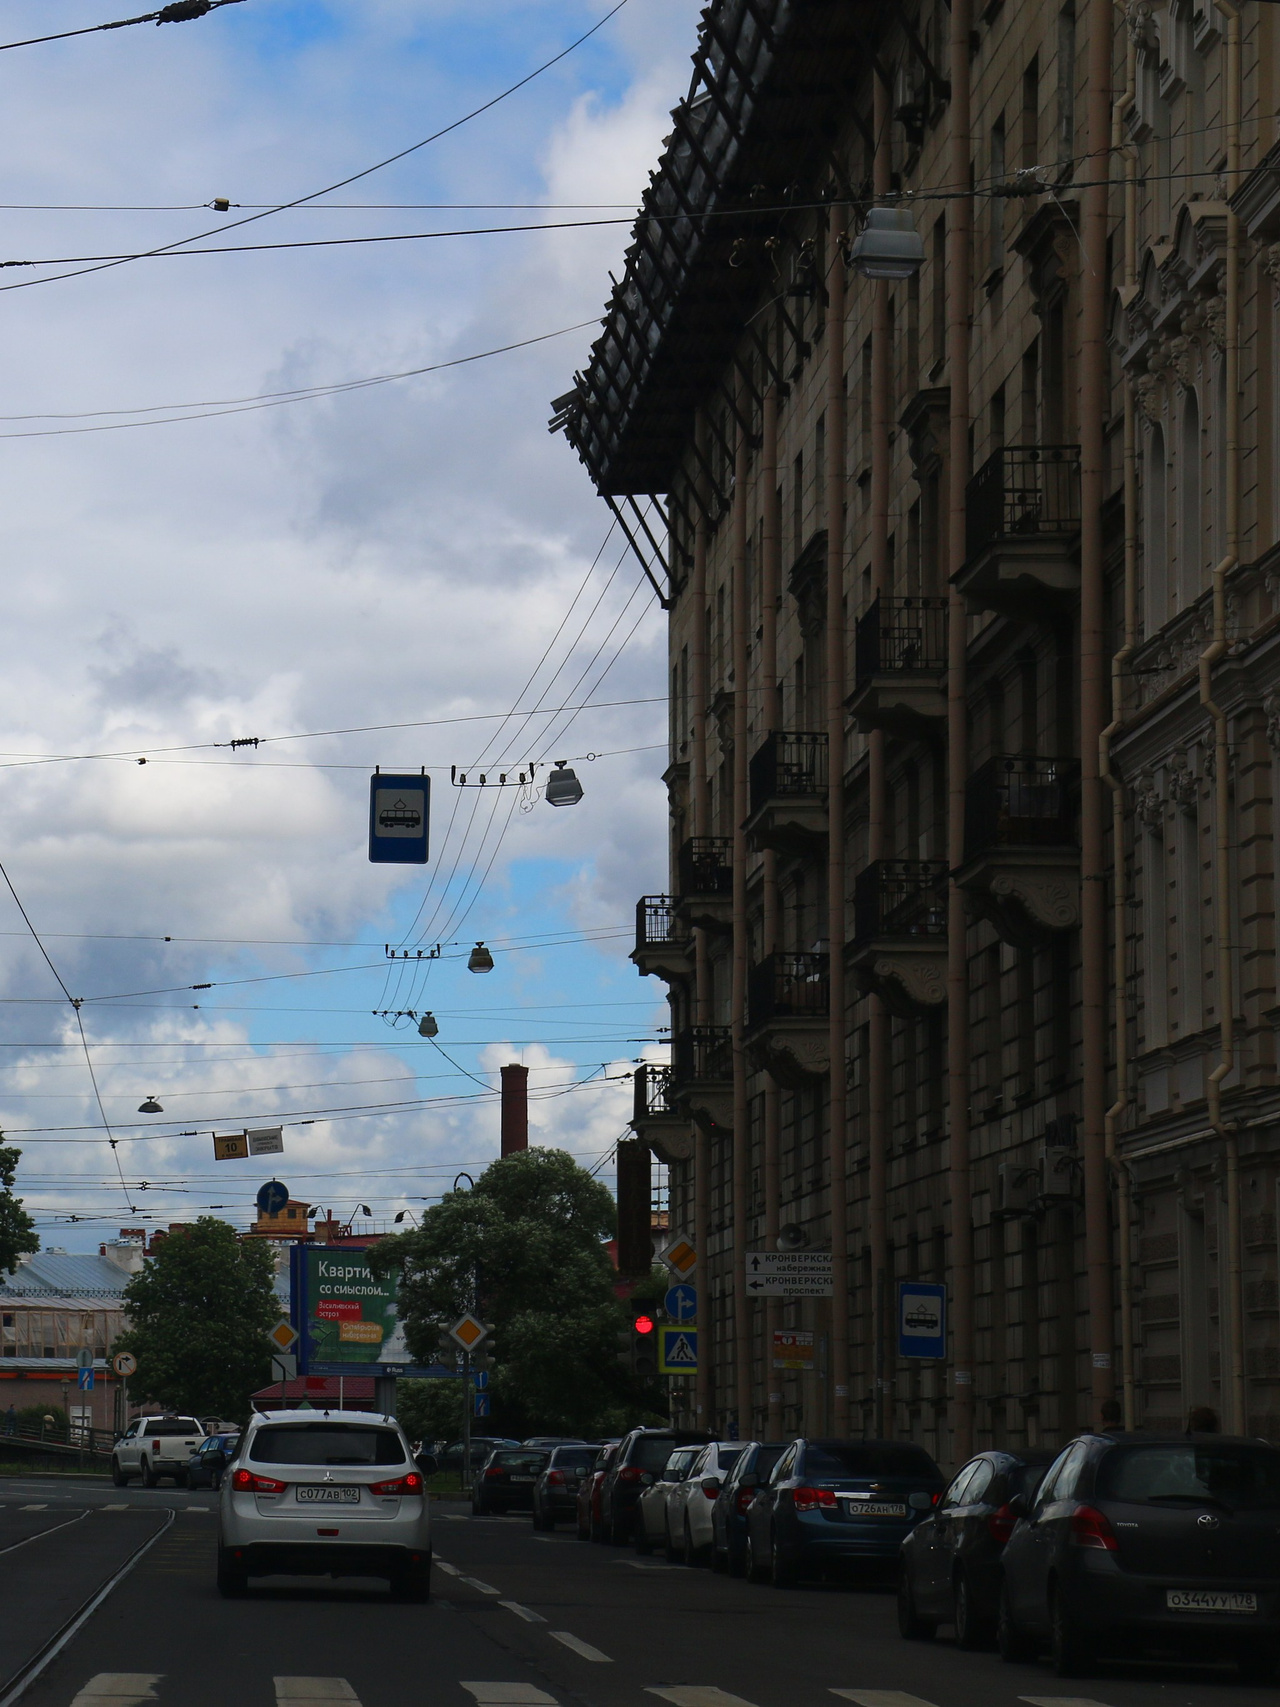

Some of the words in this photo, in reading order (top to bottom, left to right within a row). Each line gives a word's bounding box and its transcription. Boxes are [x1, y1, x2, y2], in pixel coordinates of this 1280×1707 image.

[225, 1142, 238, 1153] 10
[776, 1264, 832, 1274] набережная
[319, 1285, 332, 1294] со
[783, 1287, 825, 1296] проспект
[1171, 1592, 1228, 1607] О344УУ
[1231, 1593, 1252, 1605] 178
